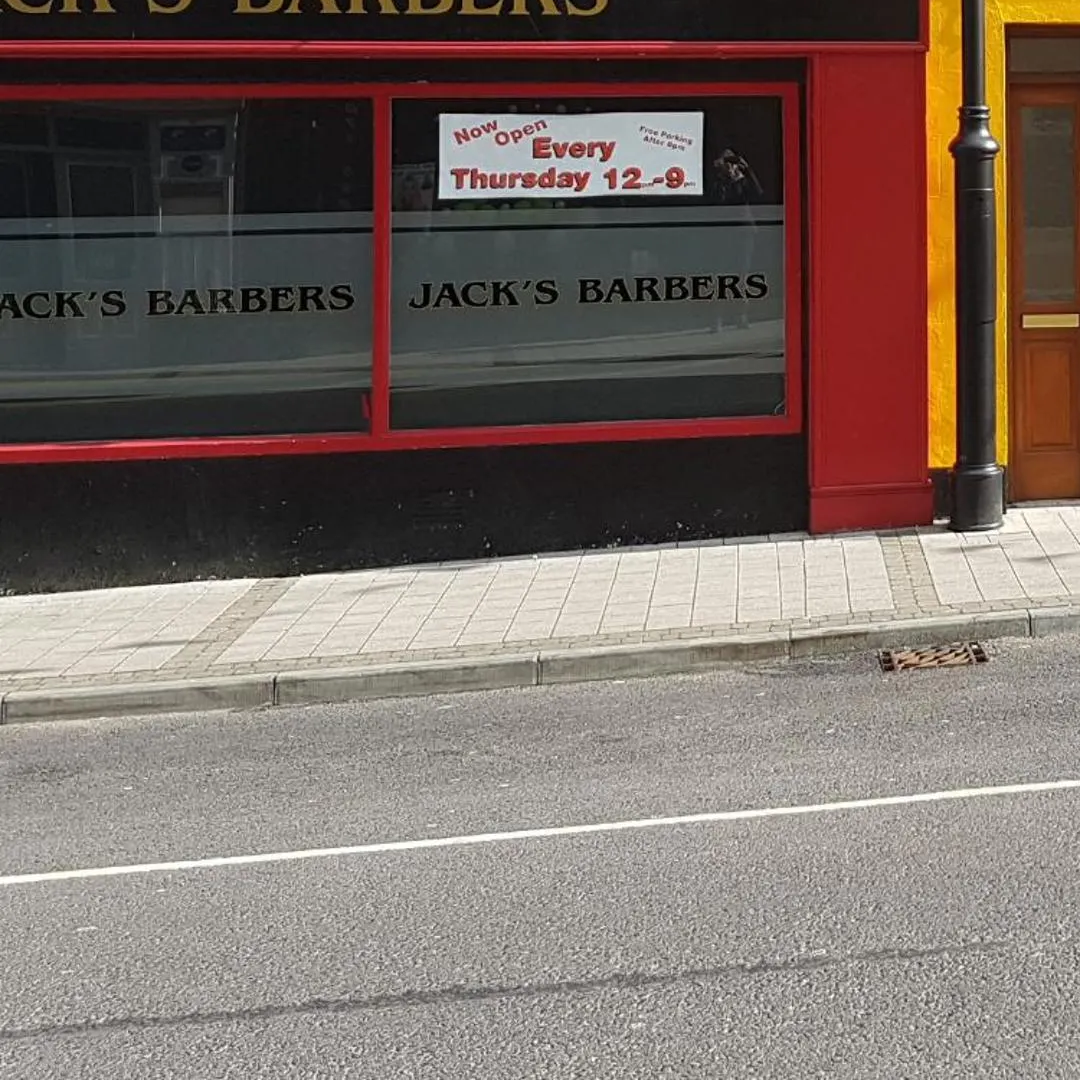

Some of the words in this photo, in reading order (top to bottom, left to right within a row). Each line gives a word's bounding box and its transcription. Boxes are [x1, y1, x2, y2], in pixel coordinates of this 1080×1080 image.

[453, 120, 498, 145] Now
[494, 120, 548, 146] Open
[532, 137, 617, 162] Every
[450, 168, 590, 191] Thursday
[146, 283, 356, 316] BARBERS
[408, 278, 560, 310] JACK'S
[577, 273, 769, 305] BARBERS
